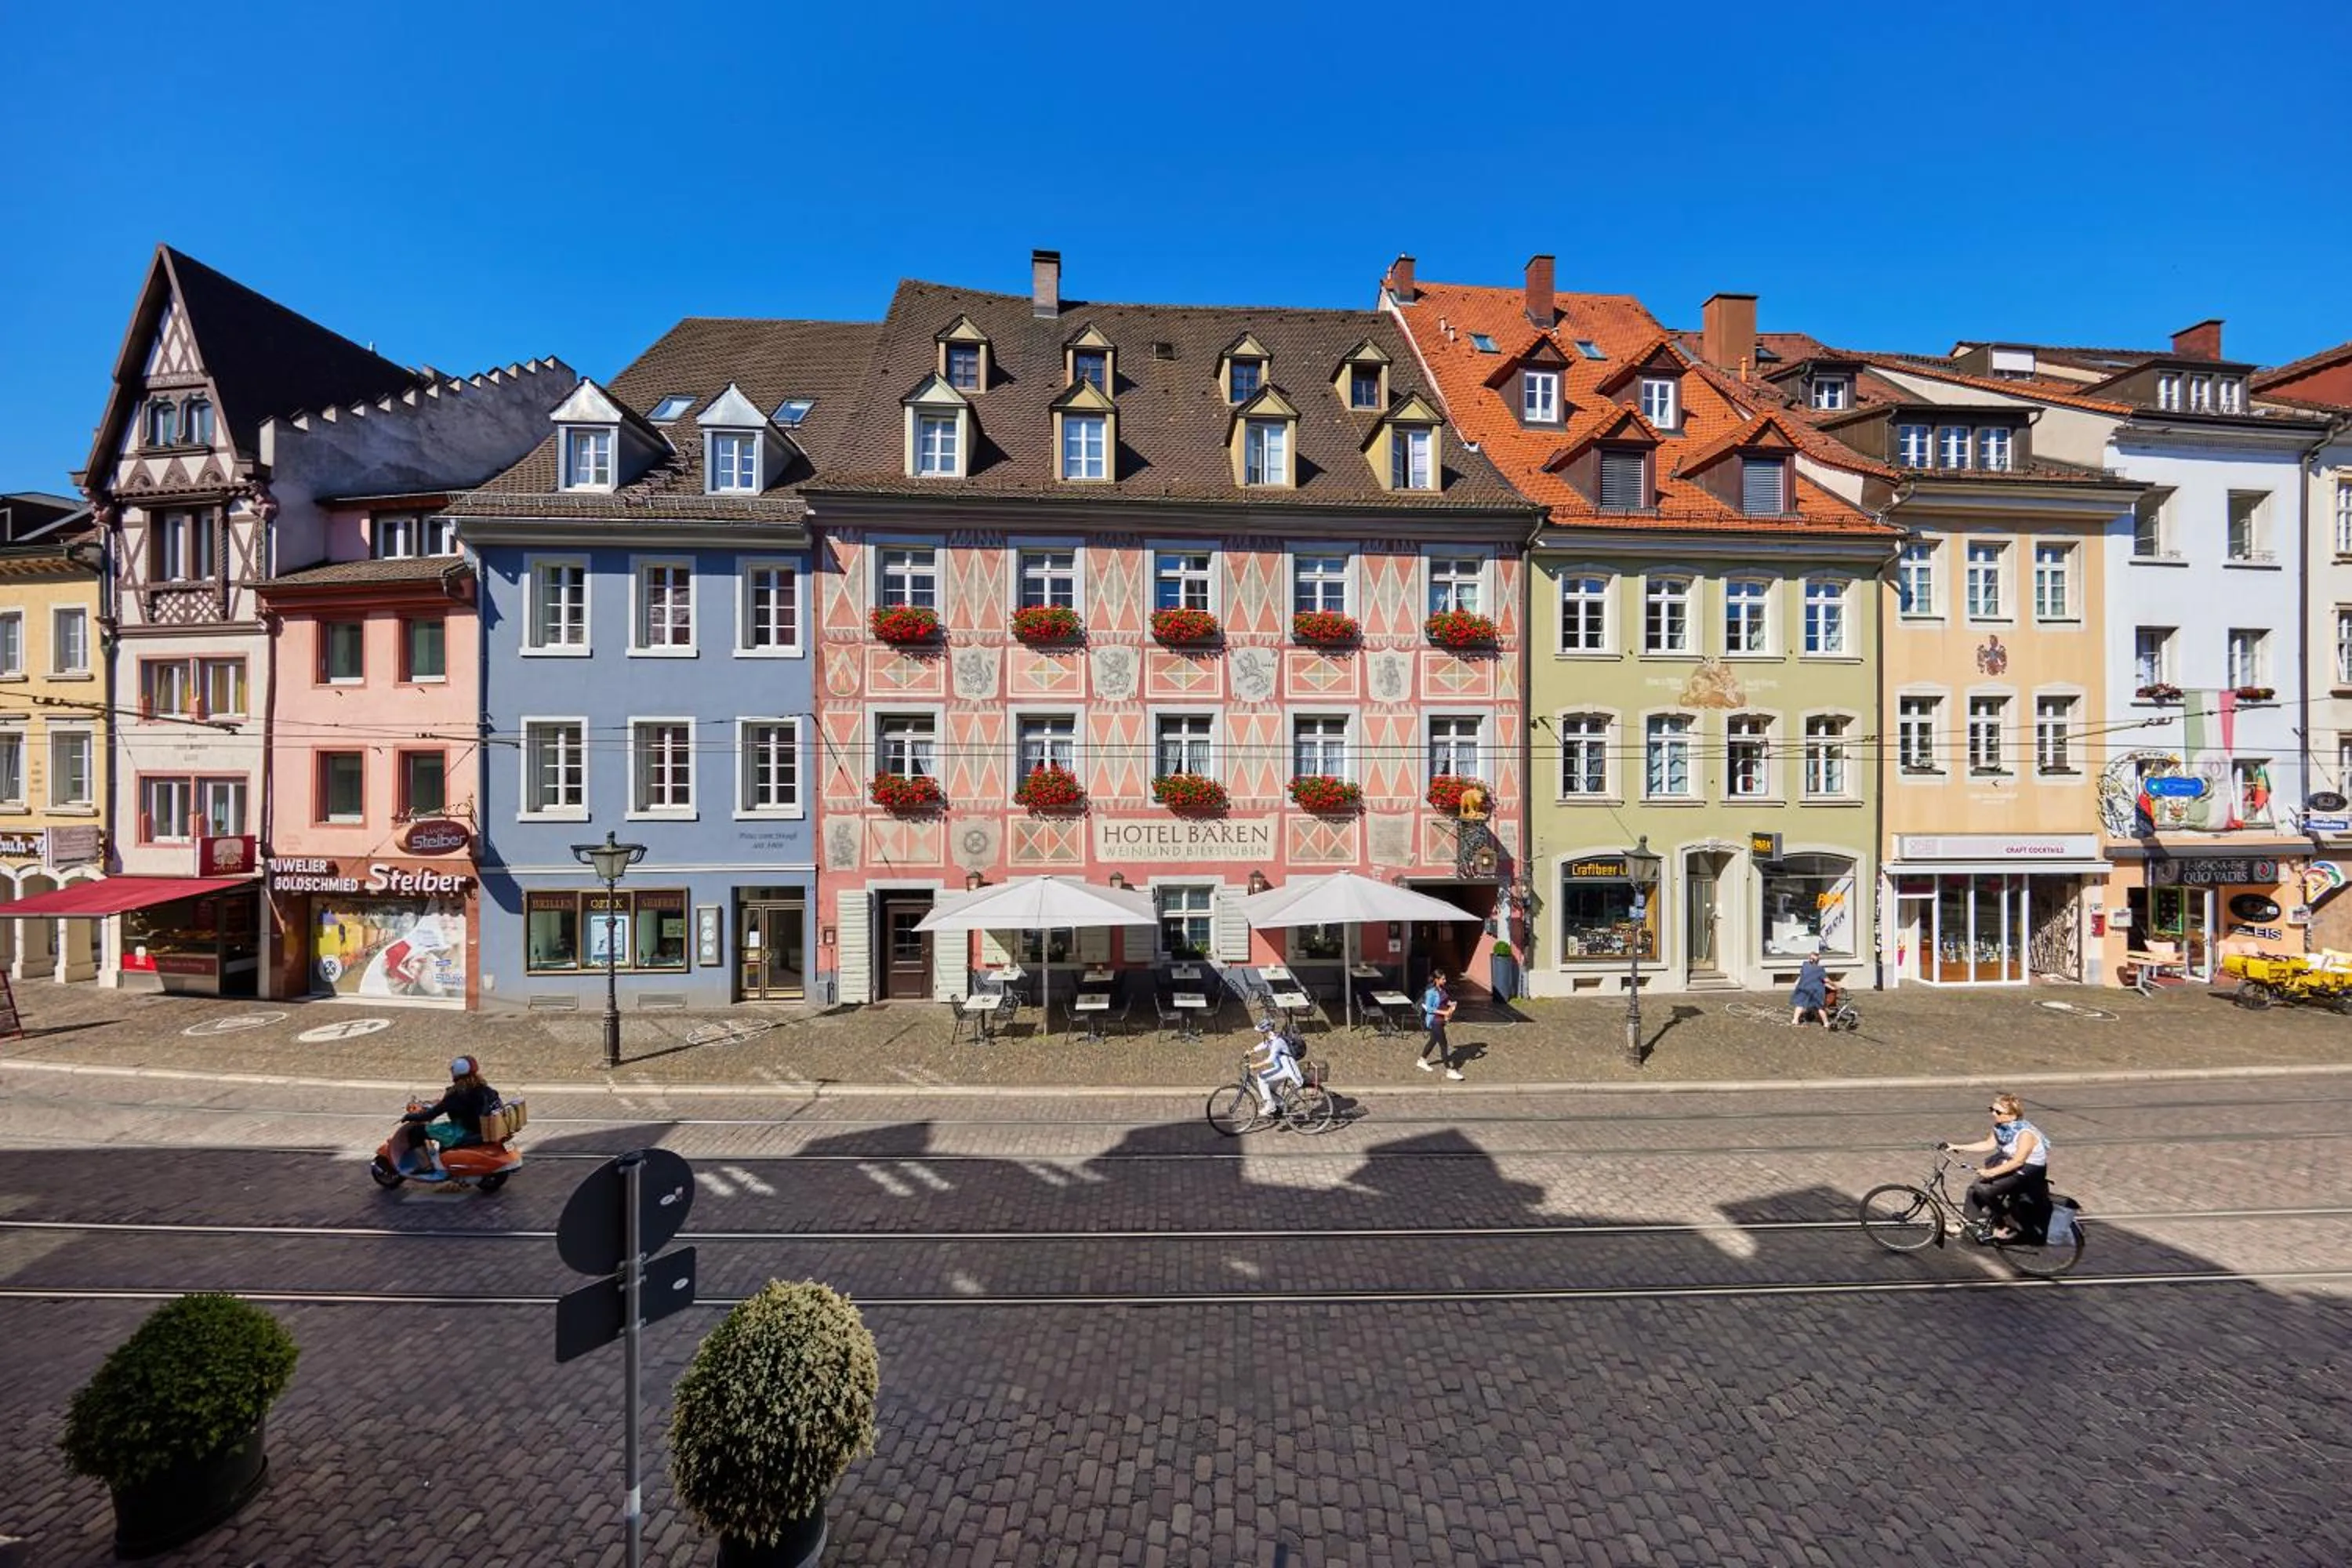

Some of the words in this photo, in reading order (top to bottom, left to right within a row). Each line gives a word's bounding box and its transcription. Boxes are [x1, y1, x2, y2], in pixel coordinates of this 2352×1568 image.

[412, 834, 466, 849] Steiber
[1104, 826, 1181, 844] HOTEL
[1189, 825, 1268, 844] BÄREN
[365, 863, 467, 891] Steiber
[1572, 863, 1617, 876] Craftbeer
[274, 877, 358, 892] GOLDSCHMIED
[2183, 871, 2212, 884] QUO
[2214, 871, 2249, 883] VADIS
[590, 898, 622, 909] OPTK
